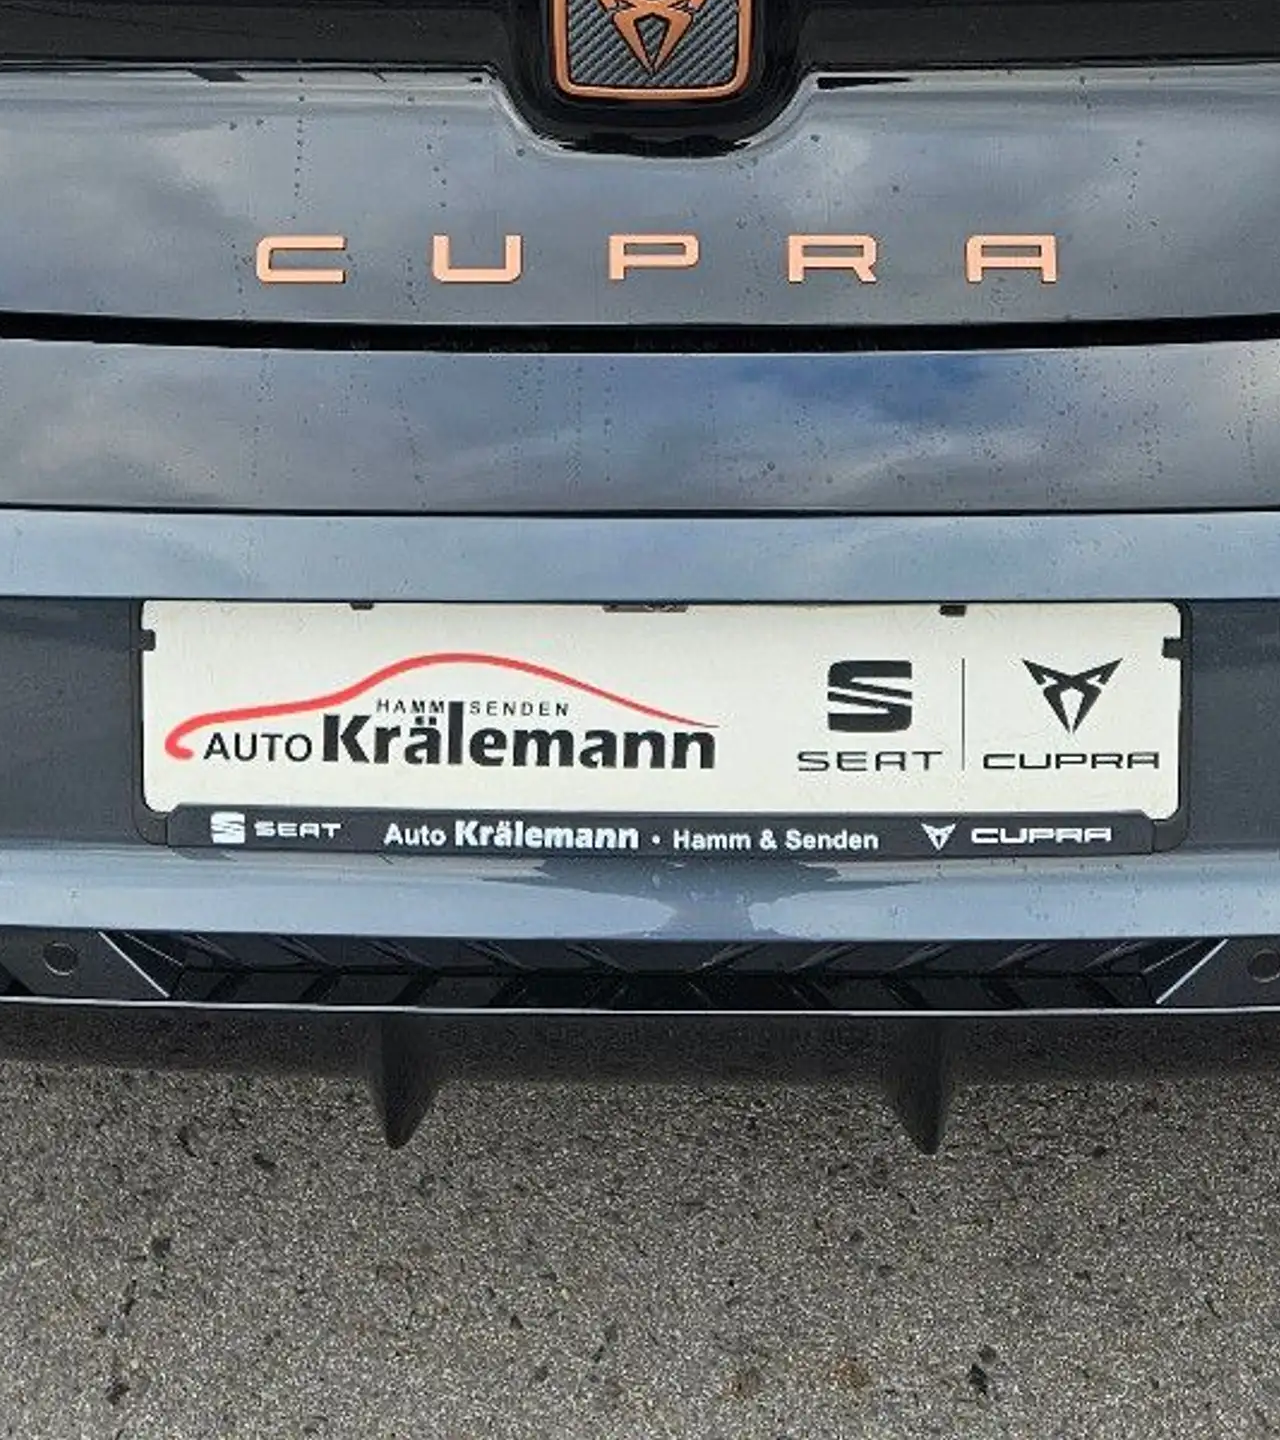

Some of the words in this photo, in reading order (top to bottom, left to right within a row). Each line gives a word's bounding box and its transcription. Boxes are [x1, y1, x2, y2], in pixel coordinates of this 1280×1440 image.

[255, 234, 1059, 284] CUPRA
[378, 700, 444, 713] HAMM
[471, 701, 568, 716] SENDEN
[204, 733, 312, 761] AUTO
[323, 700, 714, 768] Krälemann
[798, 752, 942, 771] SEAT
[984, 753, 1158, 769] CUPRA
[254, 821, 341, 838] SEAT
[384, 823, 446, 845] Auto
[455, 820, 638, 849] Krälemann
[674, 830, 751, 850] Hamm
[760, 829, 777, 850] &
[785, 829, 878, 850] Senden
[971, 828, 1111, 843] CUPRA
